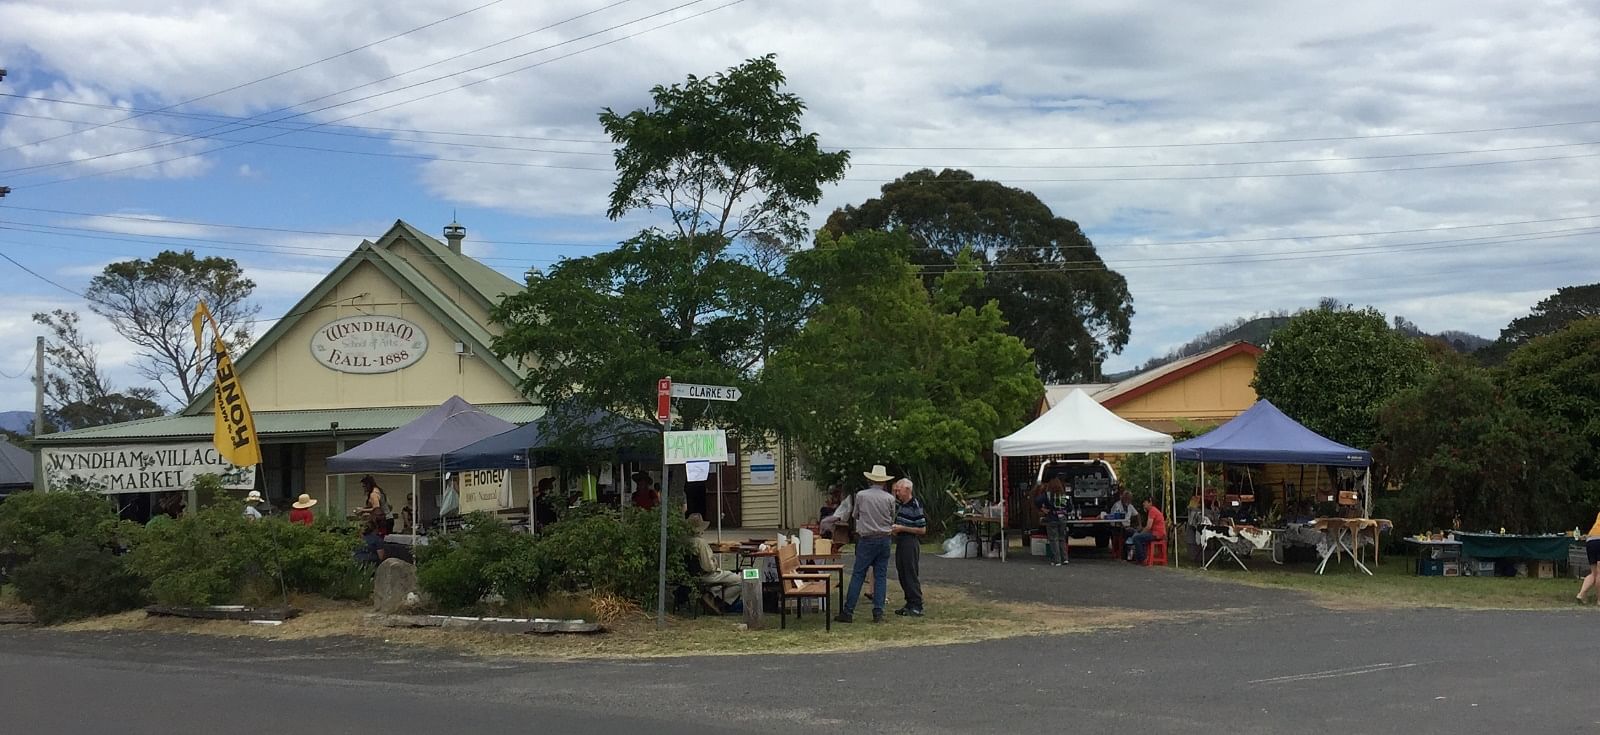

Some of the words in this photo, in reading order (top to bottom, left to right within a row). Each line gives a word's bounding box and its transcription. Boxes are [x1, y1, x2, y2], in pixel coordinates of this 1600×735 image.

[326, 322, 413, 341] WYNDHAM
[217, 351, 249, 449] HONEY
[689, 386, 722, 399] CLARKE
[726, 389, 735, 399] ST
[49, 451, 143, 470] WYNDHAM
[110, 470, 184, 490] MARKET
